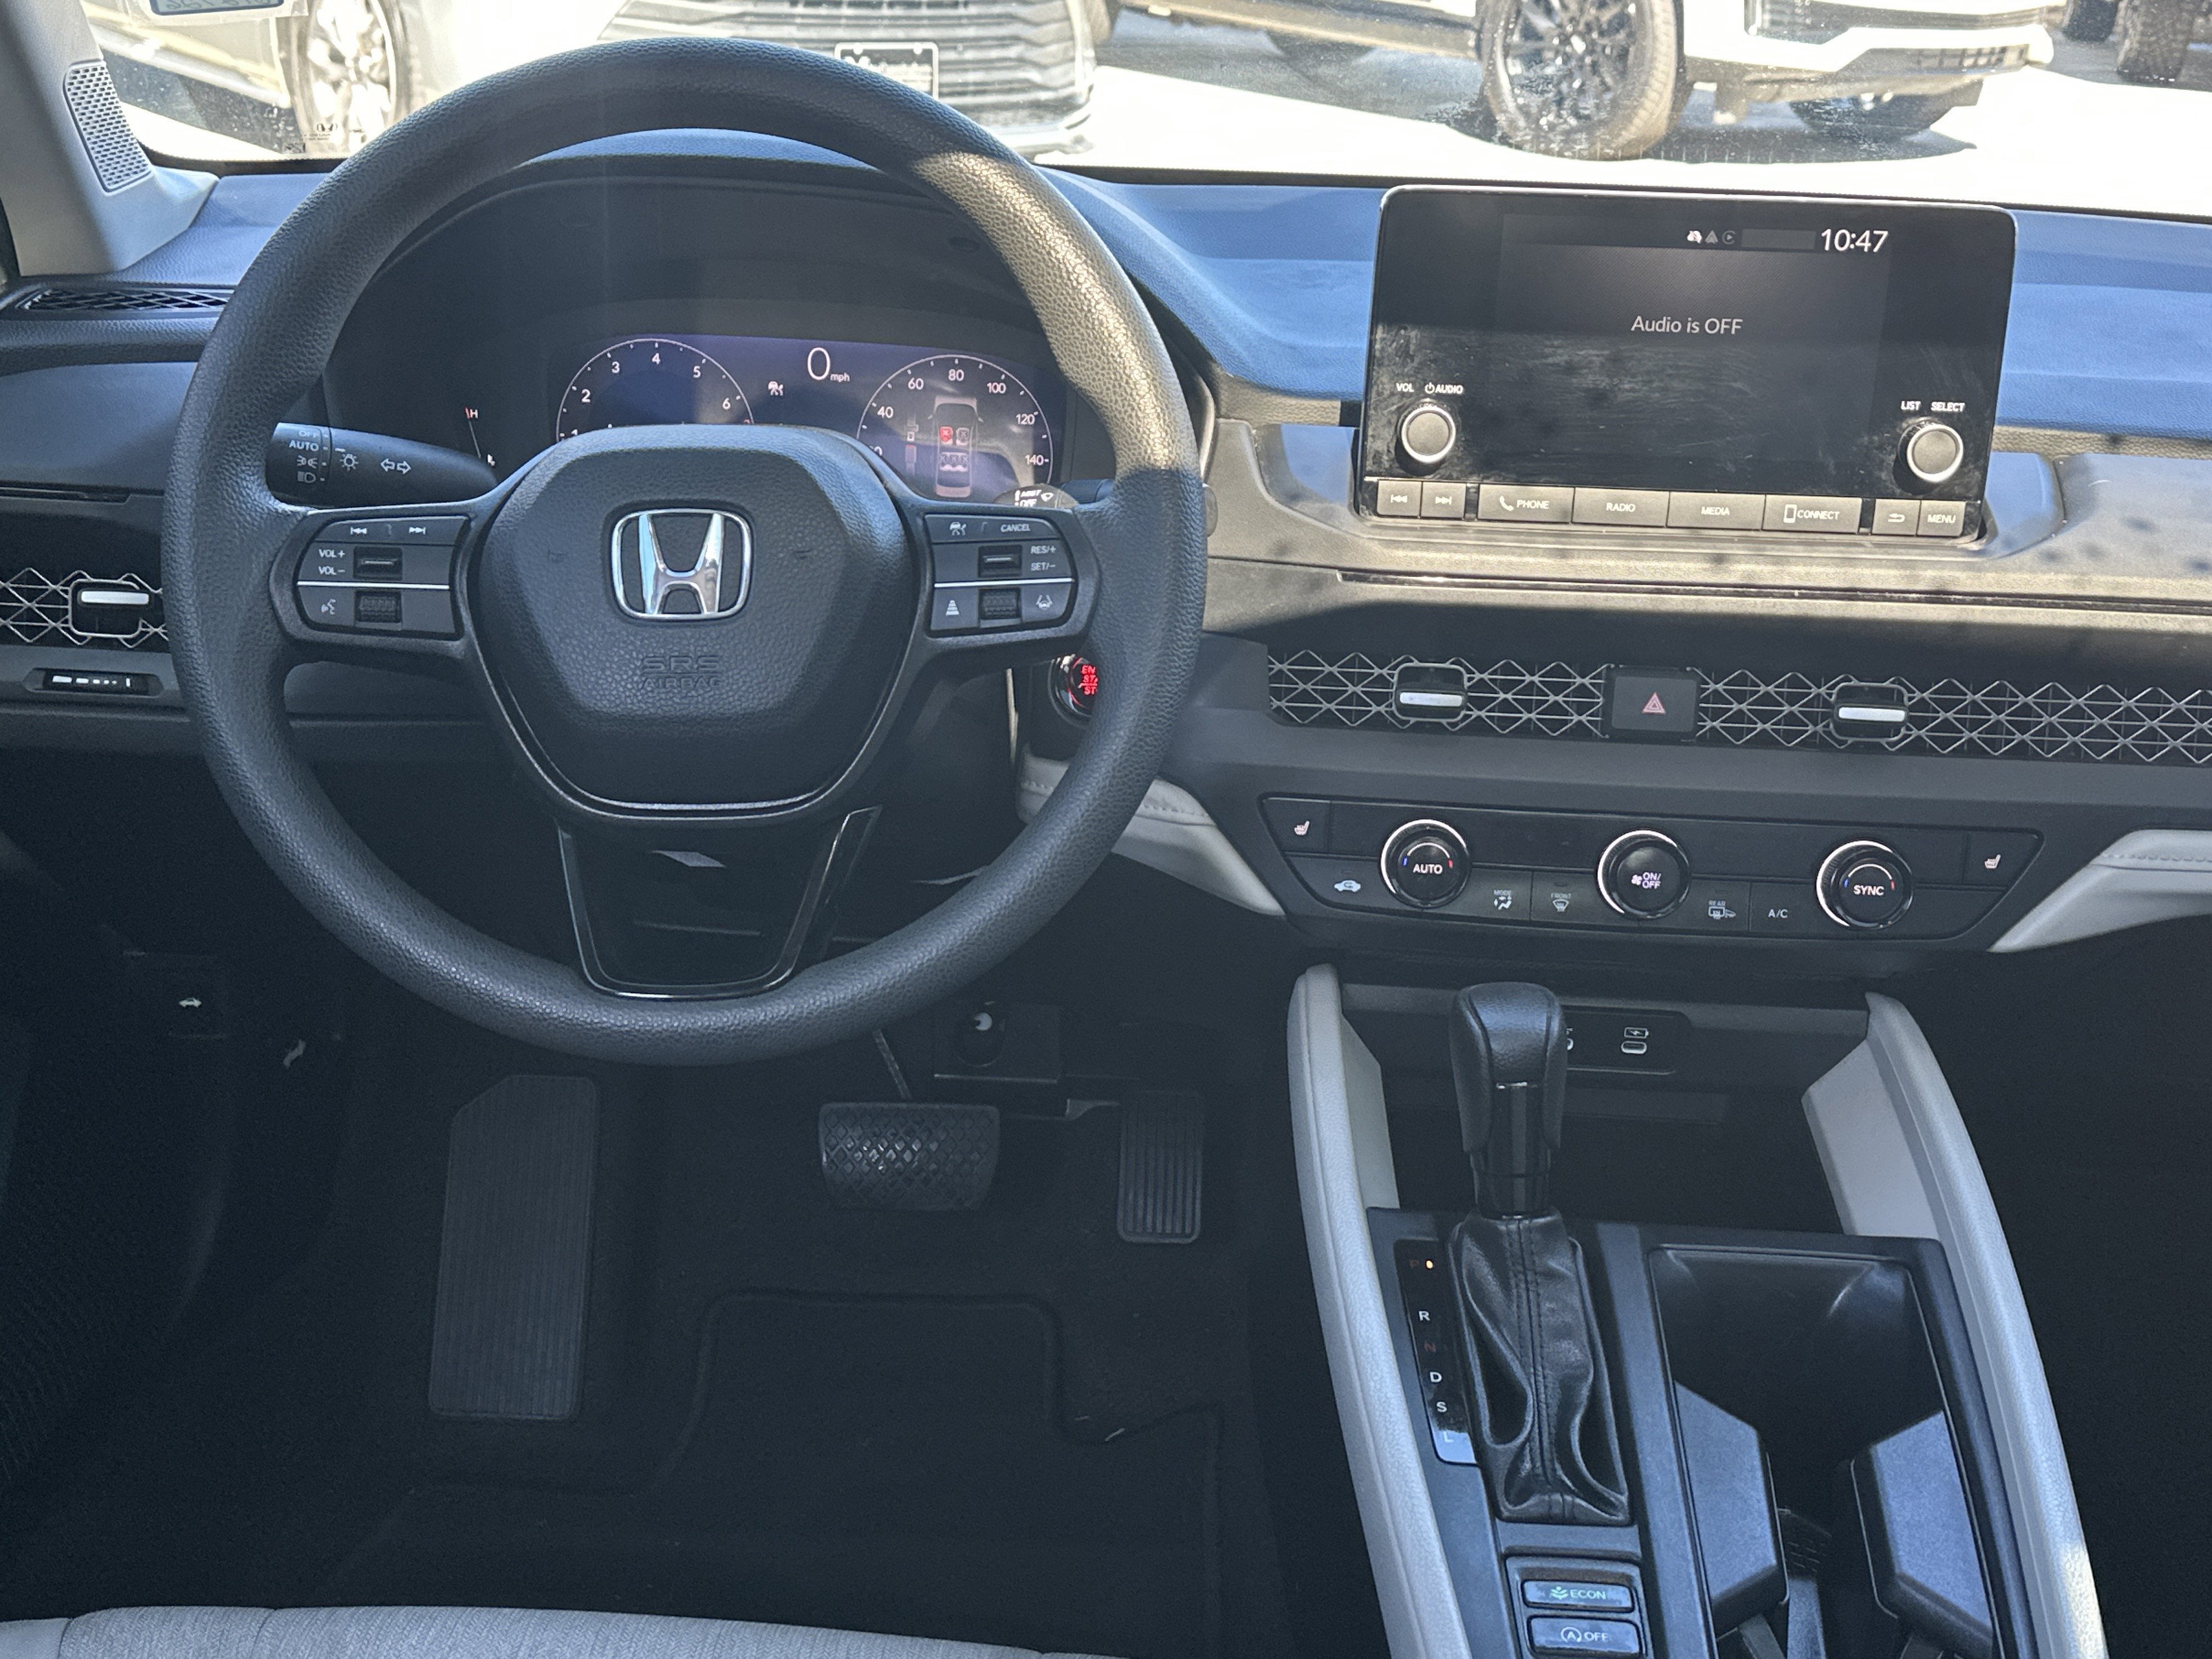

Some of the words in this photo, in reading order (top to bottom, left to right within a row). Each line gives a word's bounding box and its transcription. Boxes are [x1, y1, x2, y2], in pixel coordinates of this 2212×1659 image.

[1820, 228, 1889, 253] 10:47
[1630, 315, 1682, 333] Audio
[1686, 317, 1700, 334] is
[1704, 318, 1743, 335] OFF
[651, 353, 661, 365] 4
[807, 347, 831, 381] 0
[830, 373, 850, 383] mph
[611, 361, 620, 374] 3
[692, 365, 702, 379] 5
[948, 369, 964, 382] 80
[907, 377, 924, 391] 60
[986, 382, 1007, 394] 100
[1396, 382, 1414, 392] VOL
[1435, 384, 1464, 394] AUDIO
[581, 388, 591, 403] 2
[722, 398, 731, 410] 6
[1900, 400, 1921, 411] LIST
[1931, 401, 1966, 412] SELECT
[877, 406, 894, 419] 40
[1015, 413, 1035, 425] 120
[289, 439, 319, 452] AUTO
[1025, 454, 1044, 466] 140
[1516, 499, 1550, 510] PHONE
[1605, 502, 1636, 512] RADIO
[1701, 506, 1730, 516] MEDIA
[1797, 509, 1840, 520] CONNECT
[1927, 514, 1956, 523] MENU
[1000, 523, 1031, 533] CANCEL
[642, 655, 723, 672] SRS
[1413, 864, 1443, 875] AUTO
[1642, 872, 1662, 881] ON/
[1641, 881, 1661, 889] OFF
[1853, 884, 1884, 896] SYNC
[1768, 909, 1788, 919] A/C
[1418, 1310, 1431, 1322] R
[1429, 1372, 1442, 1383] D
[1436, 1401, 1448, 1413] S
[1443, 1432, 1453, 1443] L
[1570, 1590, 1606, 1600] ECON
[1583, 1631, 1609, 1642] OFF
